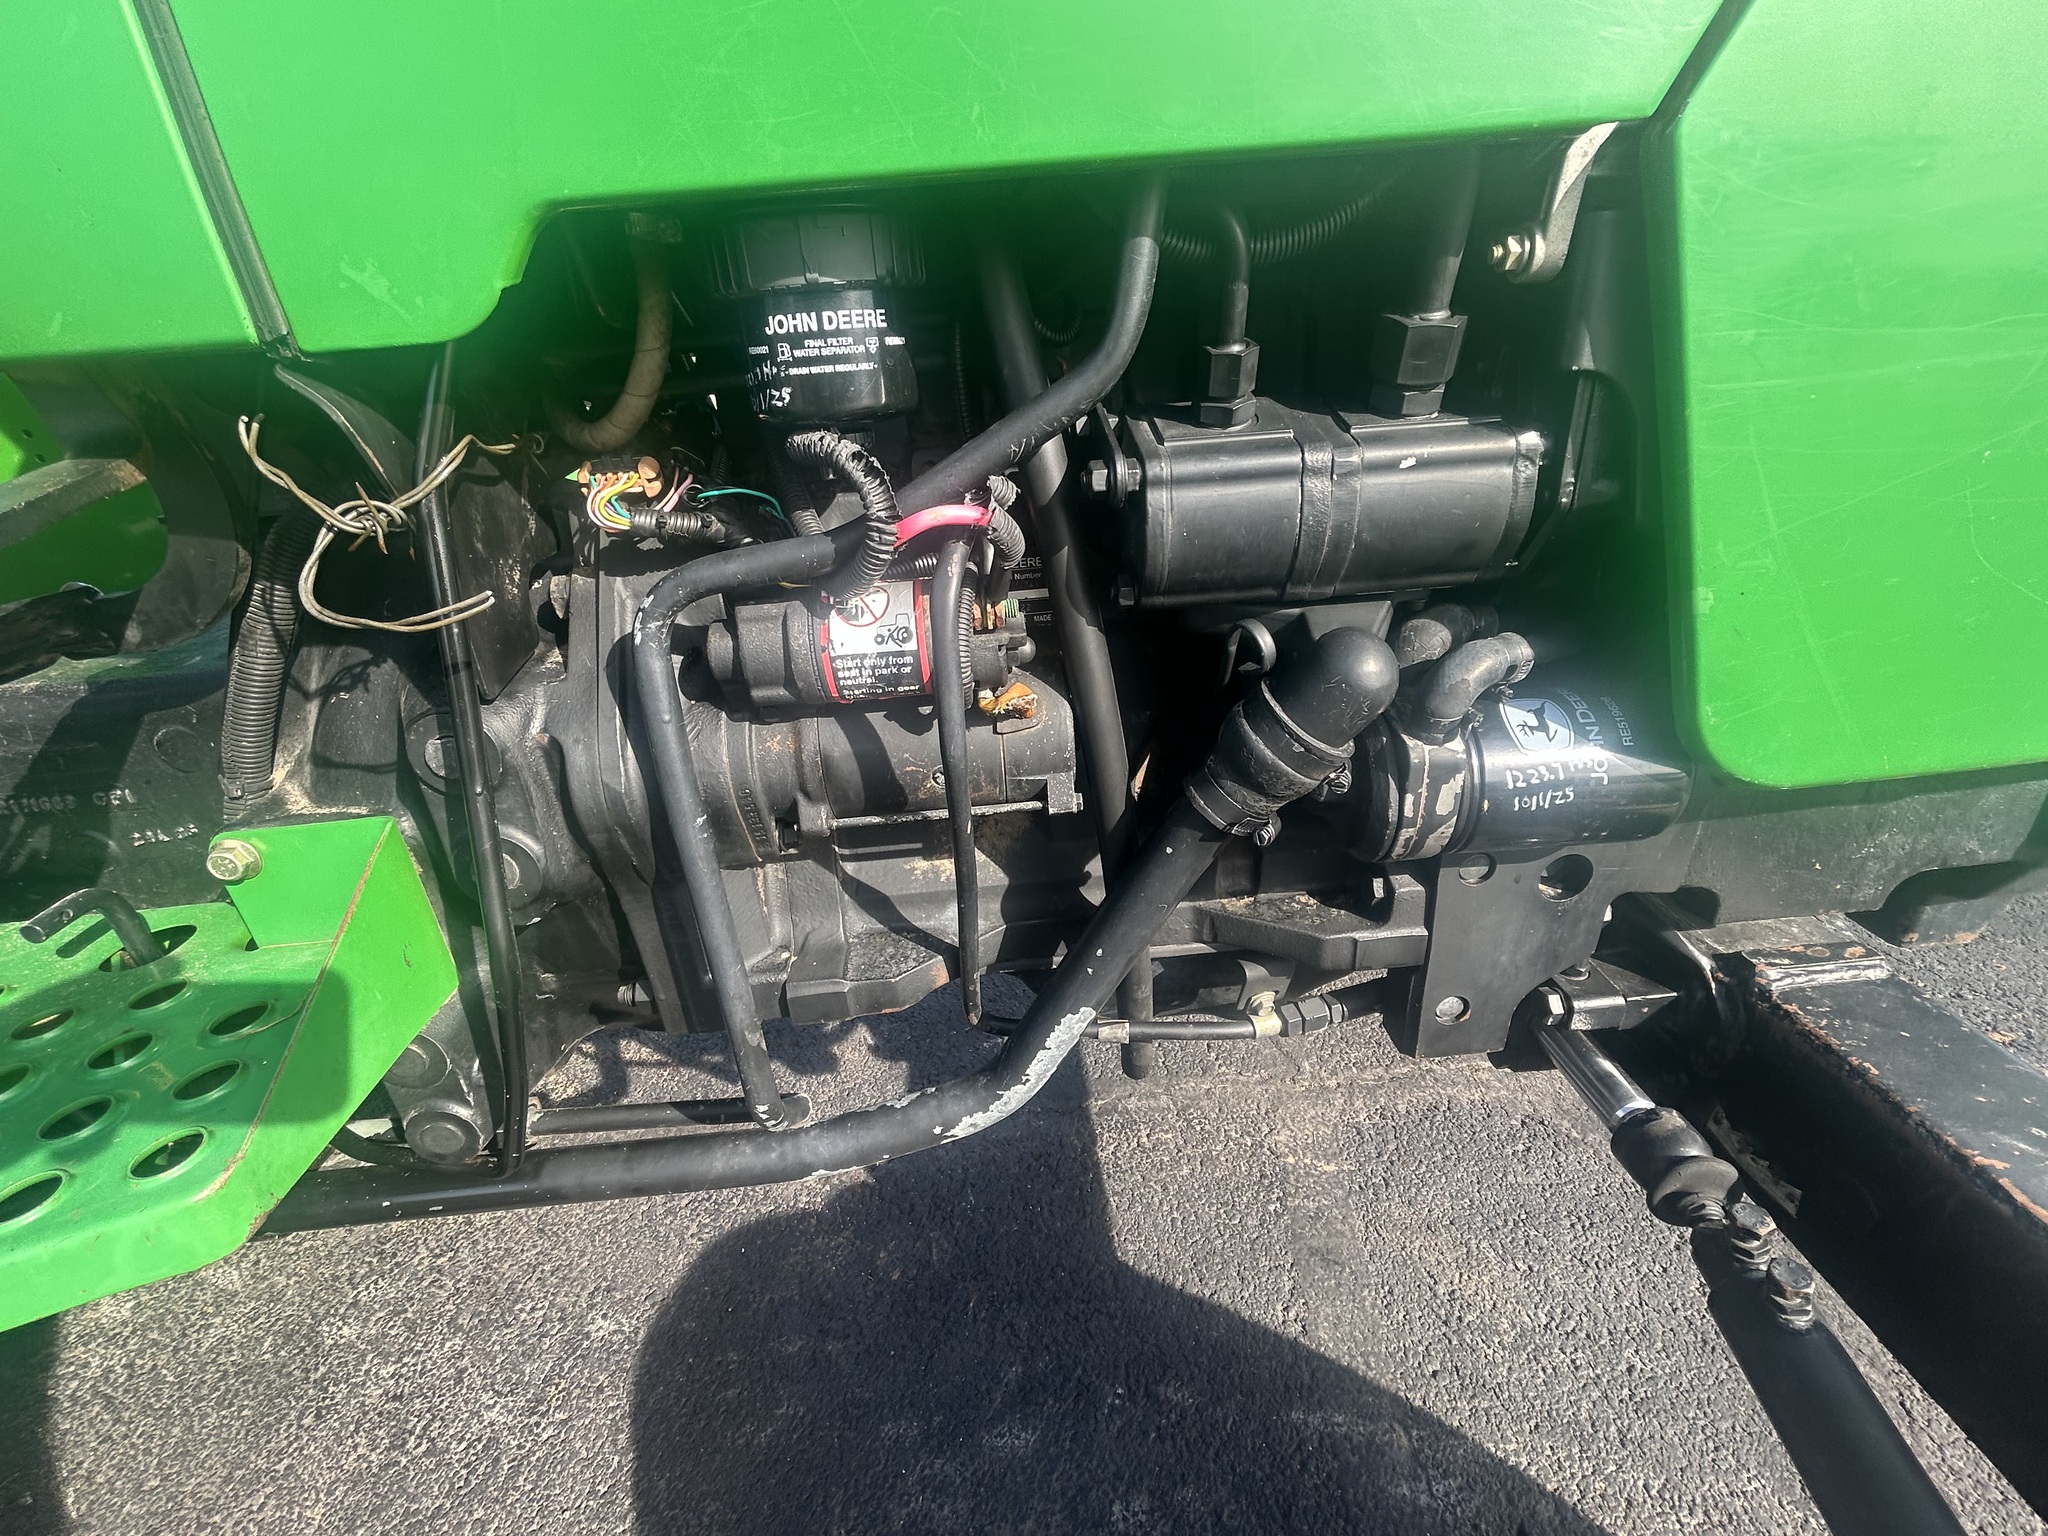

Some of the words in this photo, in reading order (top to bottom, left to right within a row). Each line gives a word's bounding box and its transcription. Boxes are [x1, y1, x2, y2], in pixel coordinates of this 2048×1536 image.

[764, 311, 818, 335] JOHN
[821, 308, 888, 331] DEERE
[804, 338, 827, 348] FINAL
[827, 336, 854, 346] FILTER
[793, 347, 820, 358] WATER
[820, 344, 866, 357] SEPARATOR
[1011, 556, 1042, 569] ERE
[1014, 571, 1042, 580] Number
[1033, 614, 1052, 622] MADE
[835, 656, 861, 668] Start
[863, 656, 888, 668] only
[889, 655, 914, 665] from
[875, 666, 899, 676] park
[900, 666, 913, 674] or
